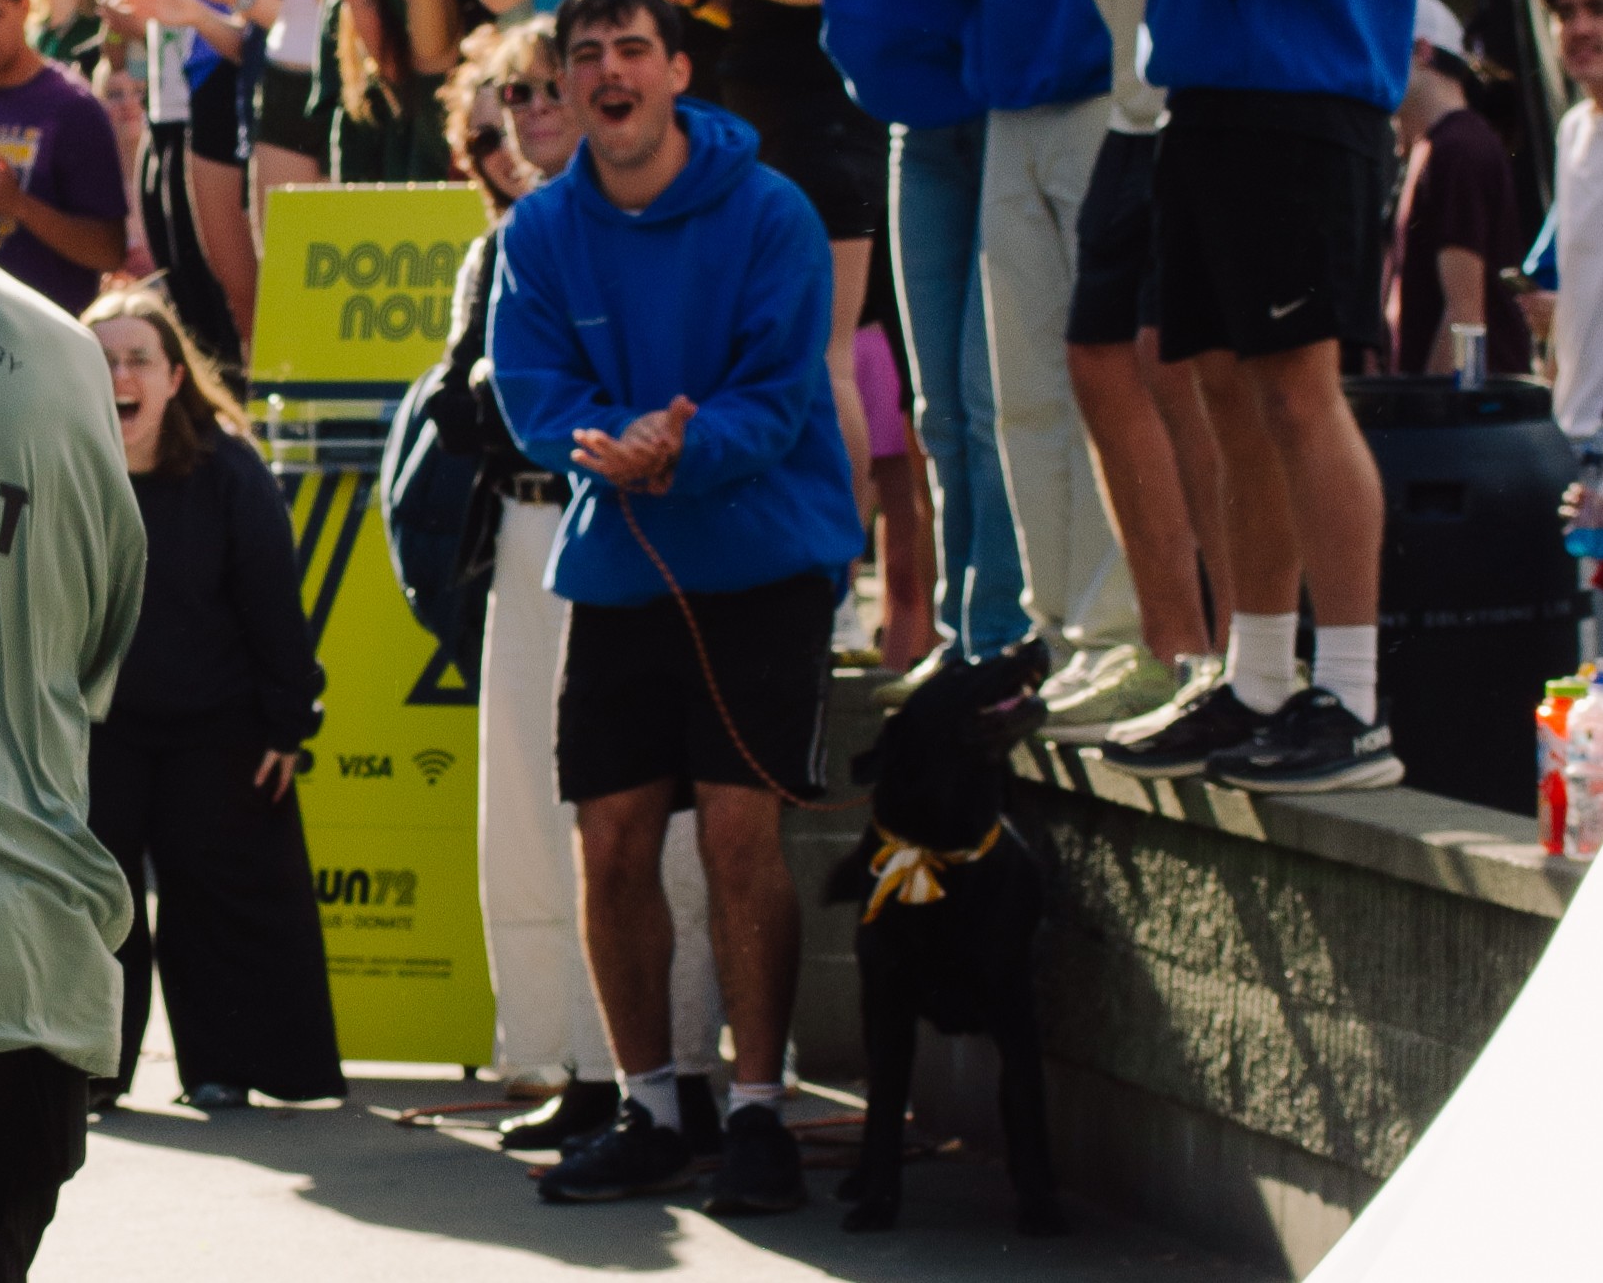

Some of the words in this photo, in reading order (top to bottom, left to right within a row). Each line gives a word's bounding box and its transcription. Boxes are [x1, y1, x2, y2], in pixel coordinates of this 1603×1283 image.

[305, 241, 472, 290] DONA
[337, 754, 393, 778] VISA
[315, 869, 418, 906] UN72
